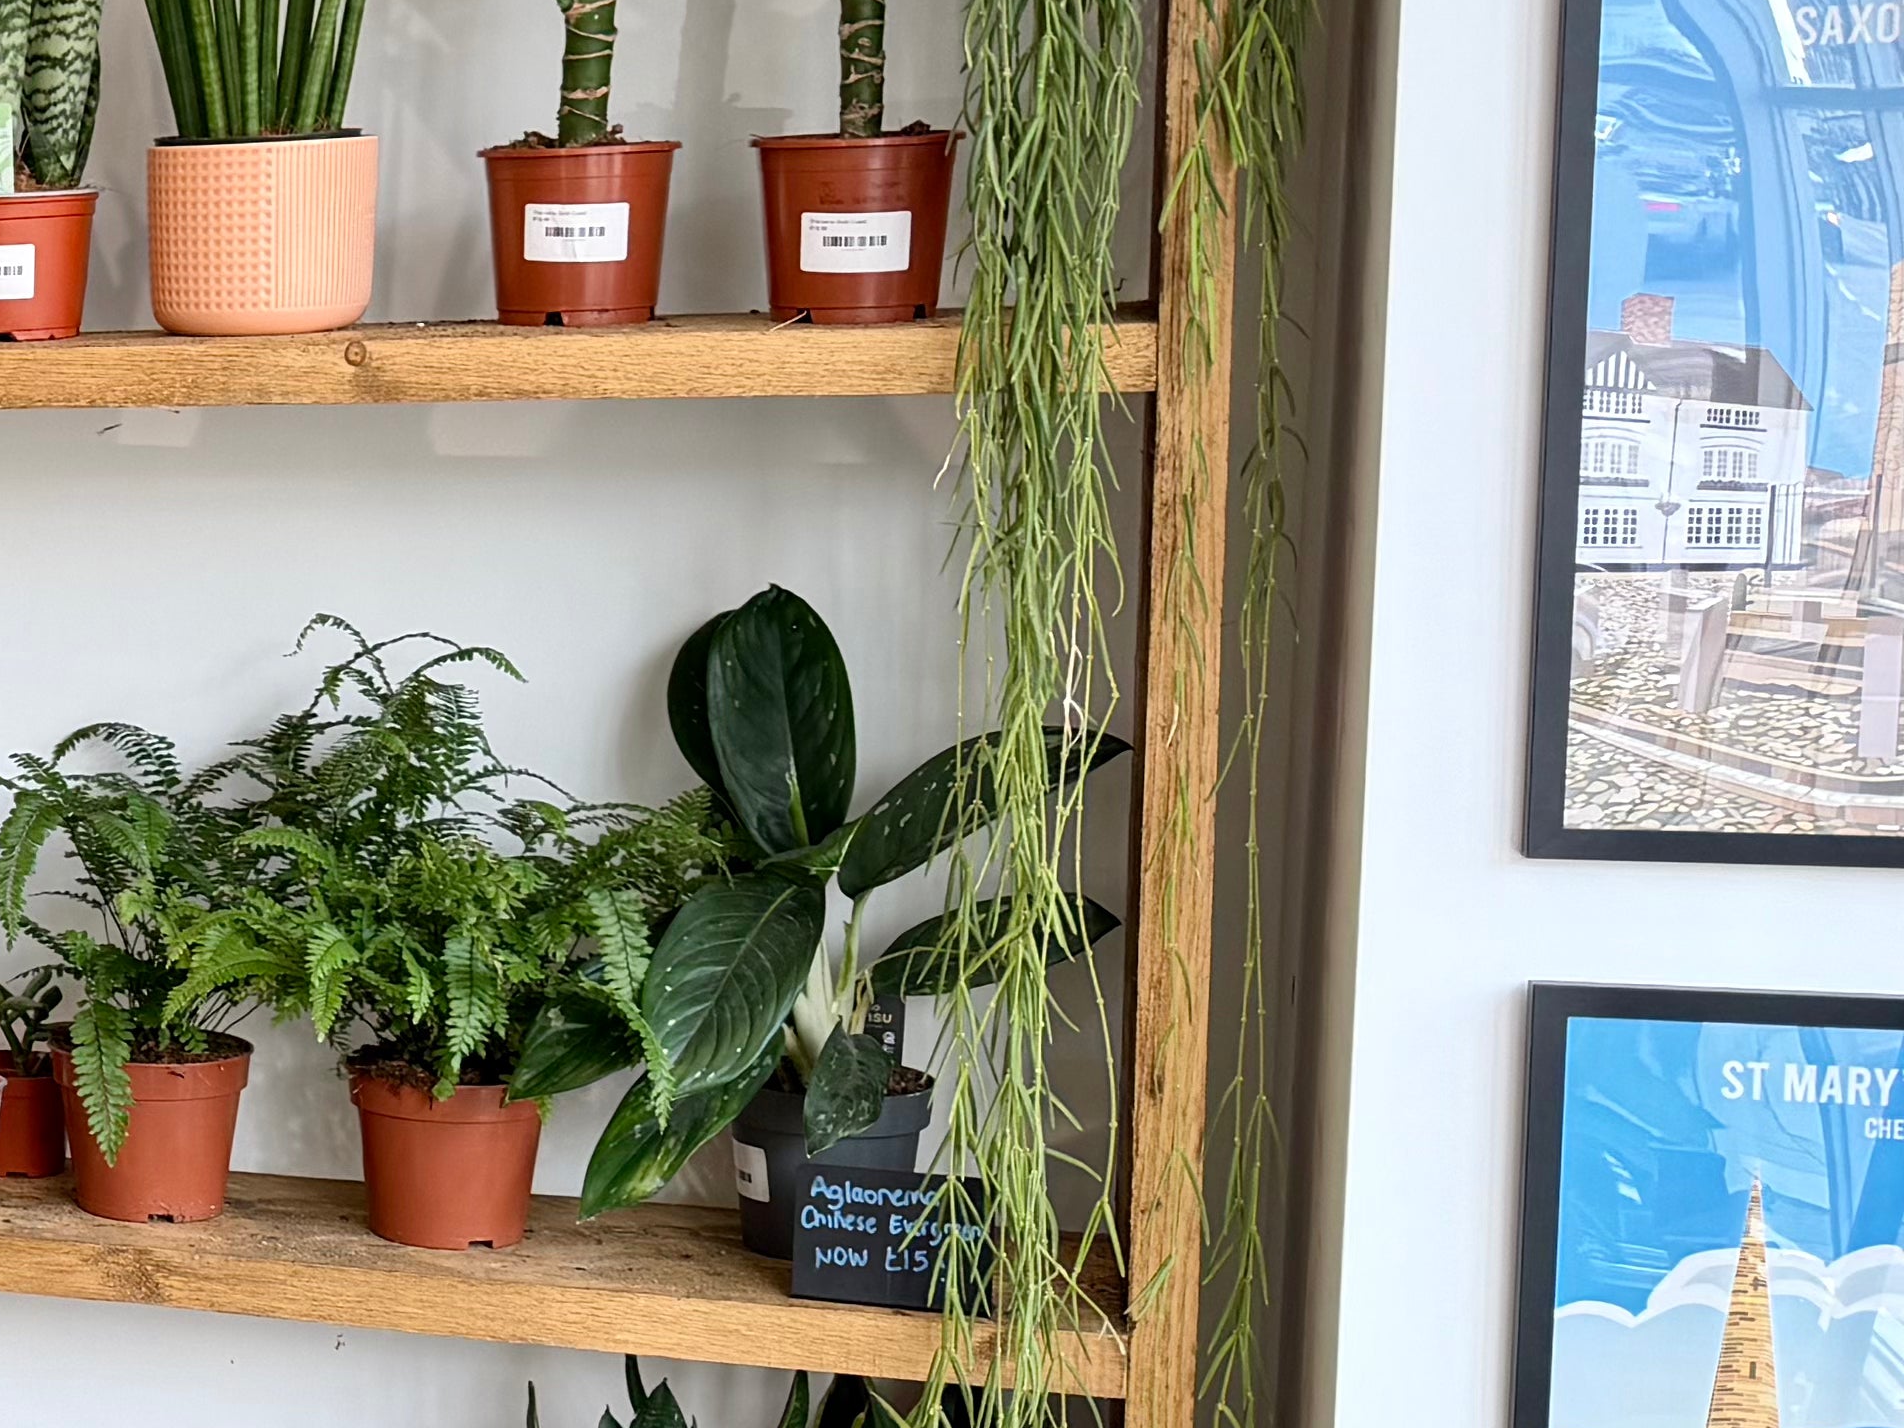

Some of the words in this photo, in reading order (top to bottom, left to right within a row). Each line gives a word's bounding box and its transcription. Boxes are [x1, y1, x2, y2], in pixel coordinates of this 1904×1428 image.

[1795, 1, 1901, 46] SAXO
[1720, 1059, 1771, 1101] ST
[1783, 1062, 1904, 1107] MARY
[1864, 1117, 1904, 1140] CHE
